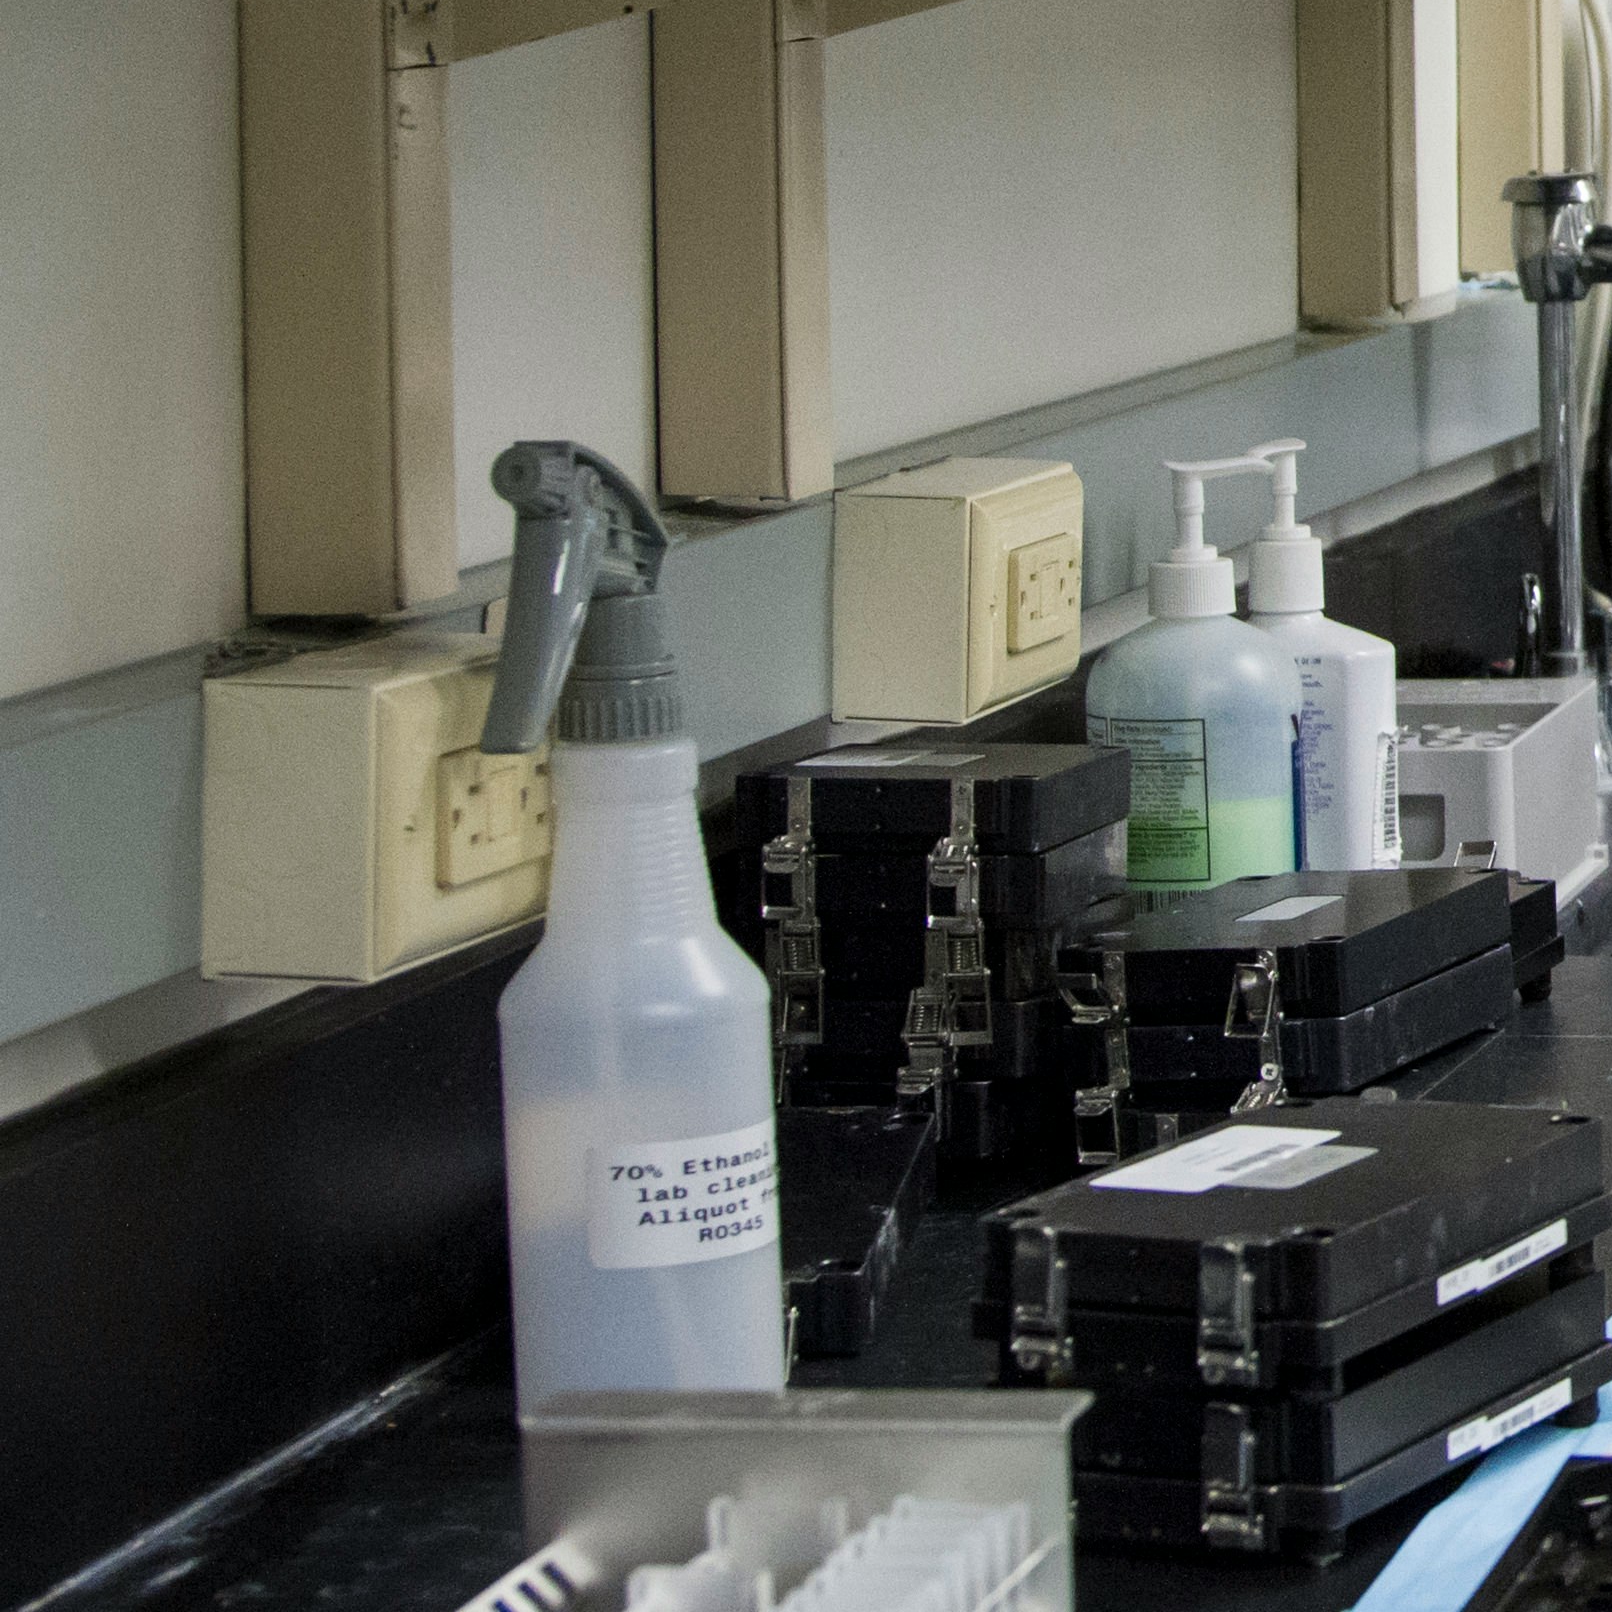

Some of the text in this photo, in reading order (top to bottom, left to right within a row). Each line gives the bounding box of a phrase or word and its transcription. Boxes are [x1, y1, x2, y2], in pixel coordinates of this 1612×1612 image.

[611, 1142, 770, 1182] 70% Ethanol
[637, 1186, 688, 1204] lab
[638, 1197, 750, 1227] Aliquot
